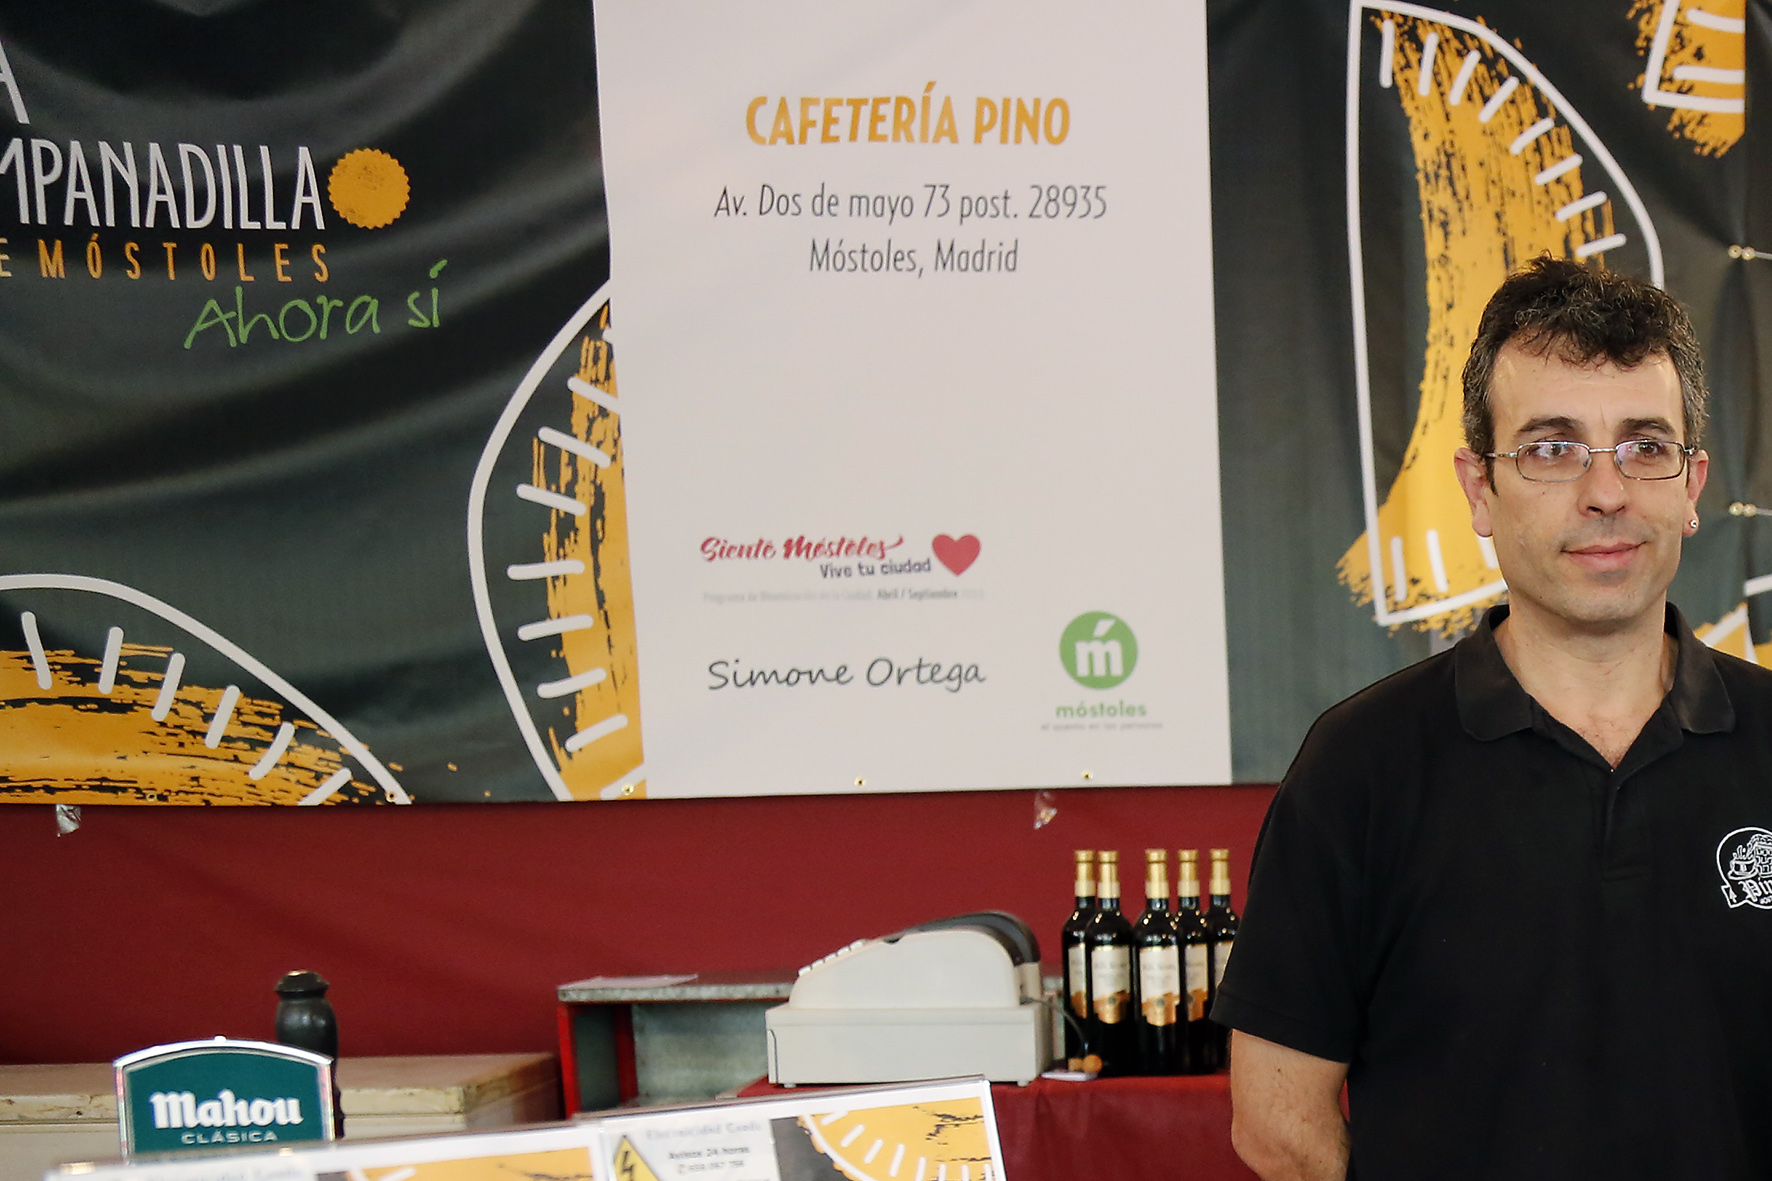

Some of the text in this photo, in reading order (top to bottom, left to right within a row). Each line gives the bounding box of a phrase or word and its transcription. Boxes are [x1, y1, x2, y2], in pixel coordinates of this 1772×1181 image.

[745, 81, 1071, 146] CAFETERÍA PINO
[0, 138, 325, 230] MPANADILLA
[714, 182, 1108, 226] Av. Dos de mayo 73 post. 28935
[39, 233, 330, 282] MÓSTOLES
[809, 238, 1018, 279] Móstoles, Madrid
[184, 260, 448, 349] Ahora sí
[820, 558, 931, 579] Vive tu ciudad
[708, 657, 986, 693] Simone Ortega
[1056, 699, 1148, 719] móstoles
[150, 1089, 304, 1129] Mahou
[181, 1130, 278, 1145] CLÁSICA
